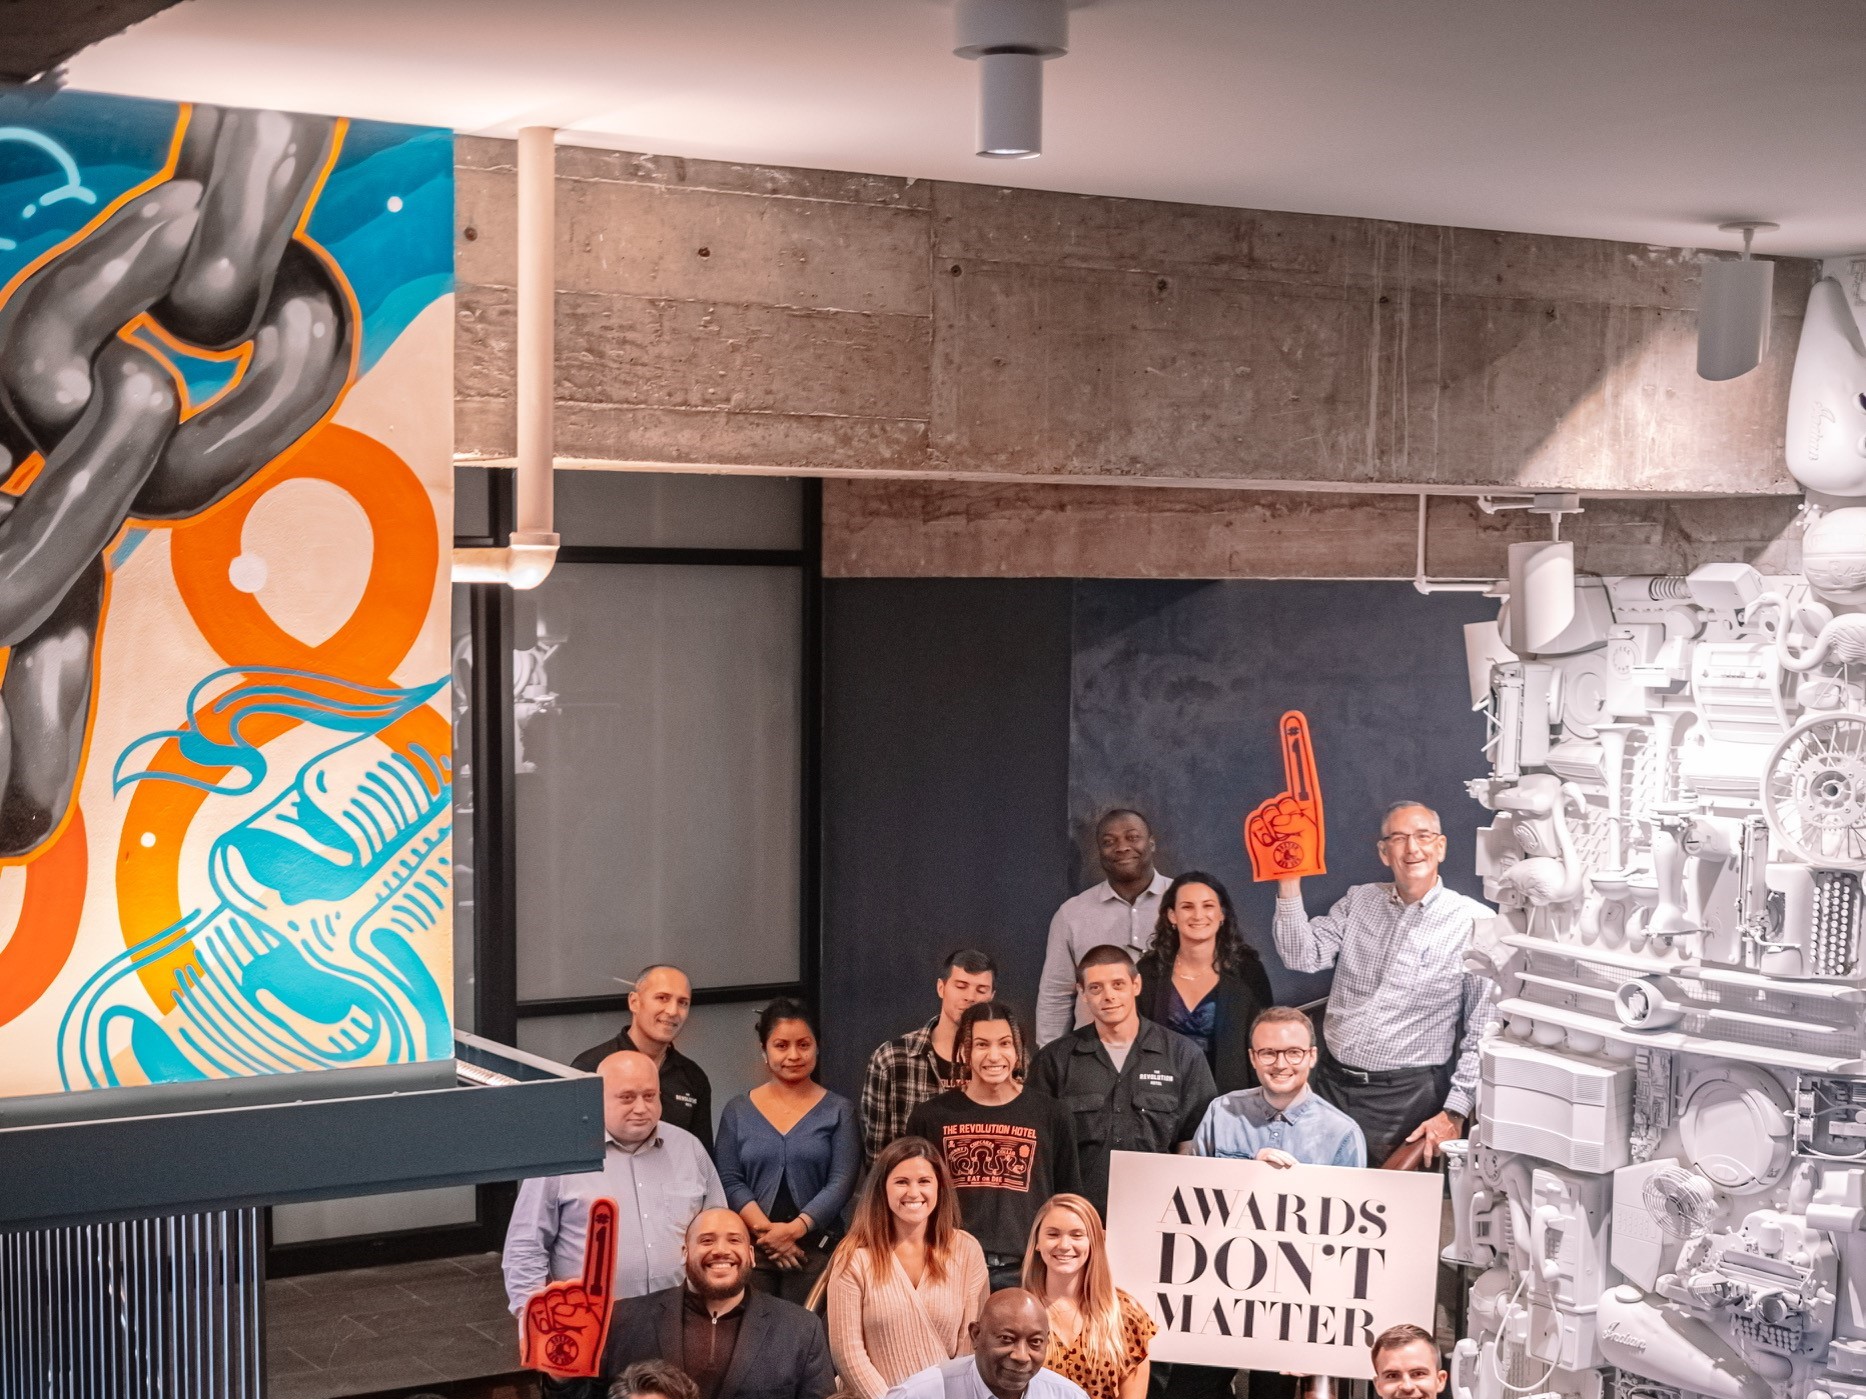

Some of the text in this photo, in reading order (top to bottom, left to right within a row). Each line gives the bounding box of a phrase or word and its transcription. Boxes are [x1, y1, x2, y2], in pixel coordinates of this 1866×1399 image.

[943, 1124, 1037, 1138] THE REVOLUTION HOTEL
[991, 1175, 1003, 1183] DIE
[1157, 1185, 1388, 1240] AWARDS
[1154, 1231, 1387, 1300] DON'T
[1153, 1291, 1375, 1348] MATTER
